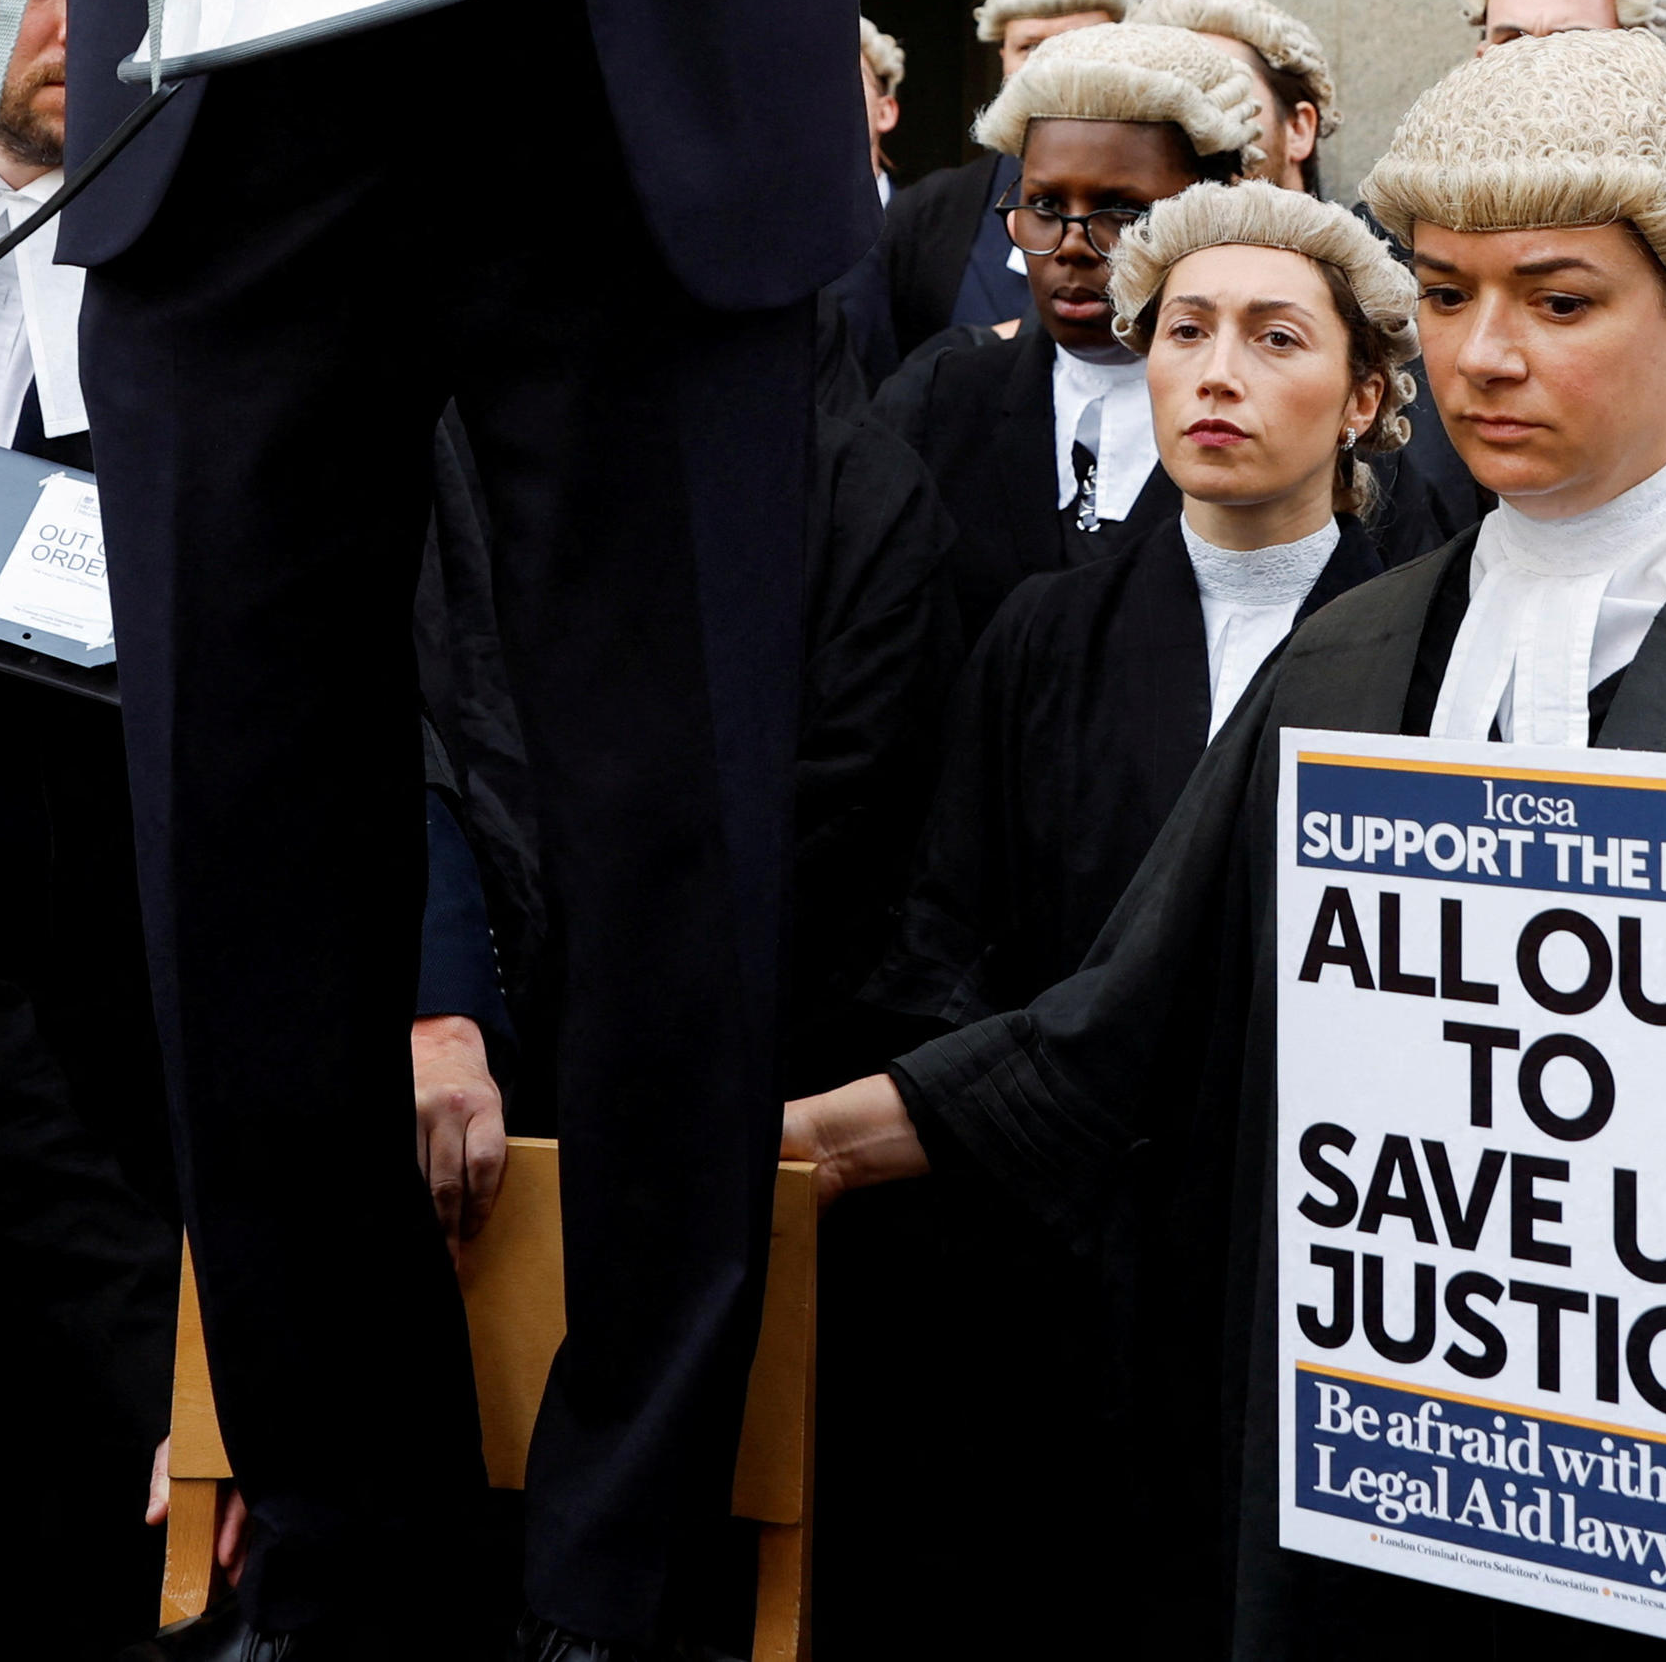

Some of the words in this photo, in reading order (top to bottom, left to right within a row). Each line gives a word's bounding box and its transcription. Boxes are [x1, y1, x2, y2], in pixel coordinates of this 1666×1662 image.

[31, 545, 107, 578] ORDE
[39, 524, 94, 550] OUT
[1484, 781, 1578, 828] lccsa
[1301, 811, 1532, 879] SUPPORT
[1544, 831, 1649, 891] THE
[1298, 886, 1499, 1006] ALL
[1442, 1020, 1615, 1141] TO
[1297, 1122, 1571, 1267] SAVE
[1313, 1382, 1381, 1442] Be
[1387, 1398, 1543, 1478] afraid
[1313, 1443, 1453, 1525] Legal
[1454, 1478, 1552, 1544] Aid
[1380, 1535, 1416, 1552] London
[1417, 1544, 1459, 1562] Criminal
[1460, 1554, 1492, 1570] Courts
[1542, 1572, 1599, 1595] Association
